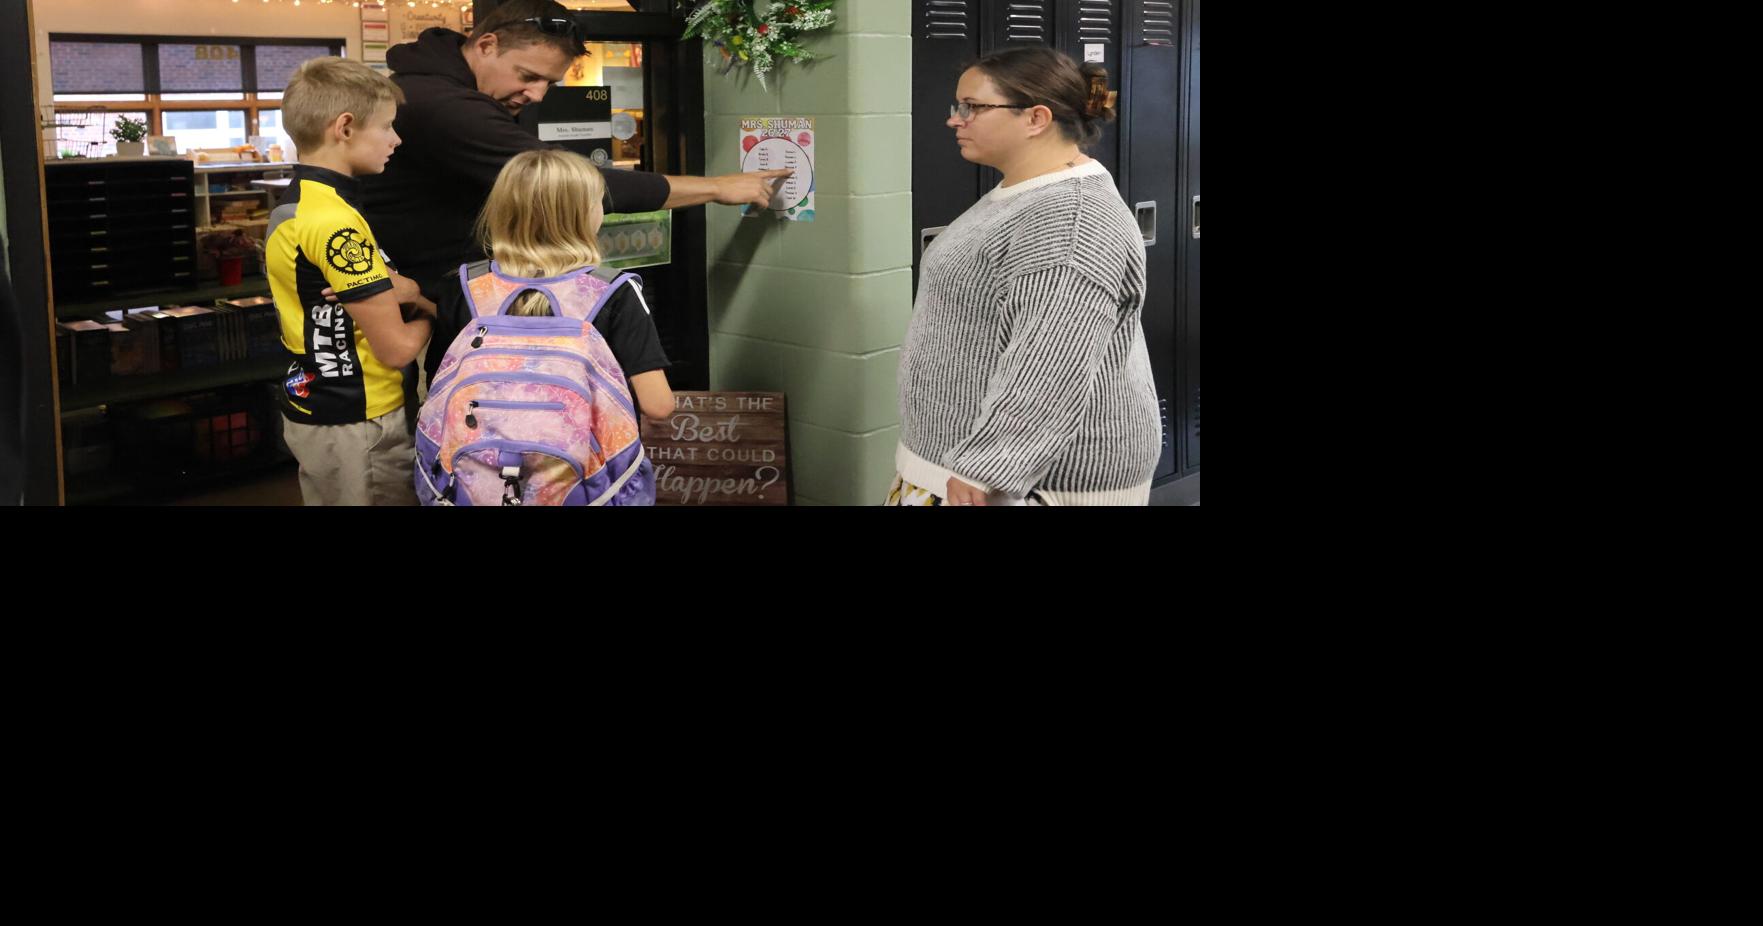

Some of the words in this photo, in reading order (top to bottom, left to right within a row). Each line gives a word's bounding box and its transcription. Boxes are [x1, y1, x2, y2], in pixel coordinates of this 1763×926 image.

[586, 89, 608, 101] 408
[767, 118, 812, 129] SHUMAN
[312, 303, 339, 377] MTB
[334, 302, 354, 377] RACING
[736, 397, 774, 410] THE
[671, 413, 752, 442] Best
[647, 446, 698, 461] THAT
[707, 448, 776, 462] COULD
[654, 464, 780, 504] Happen?
